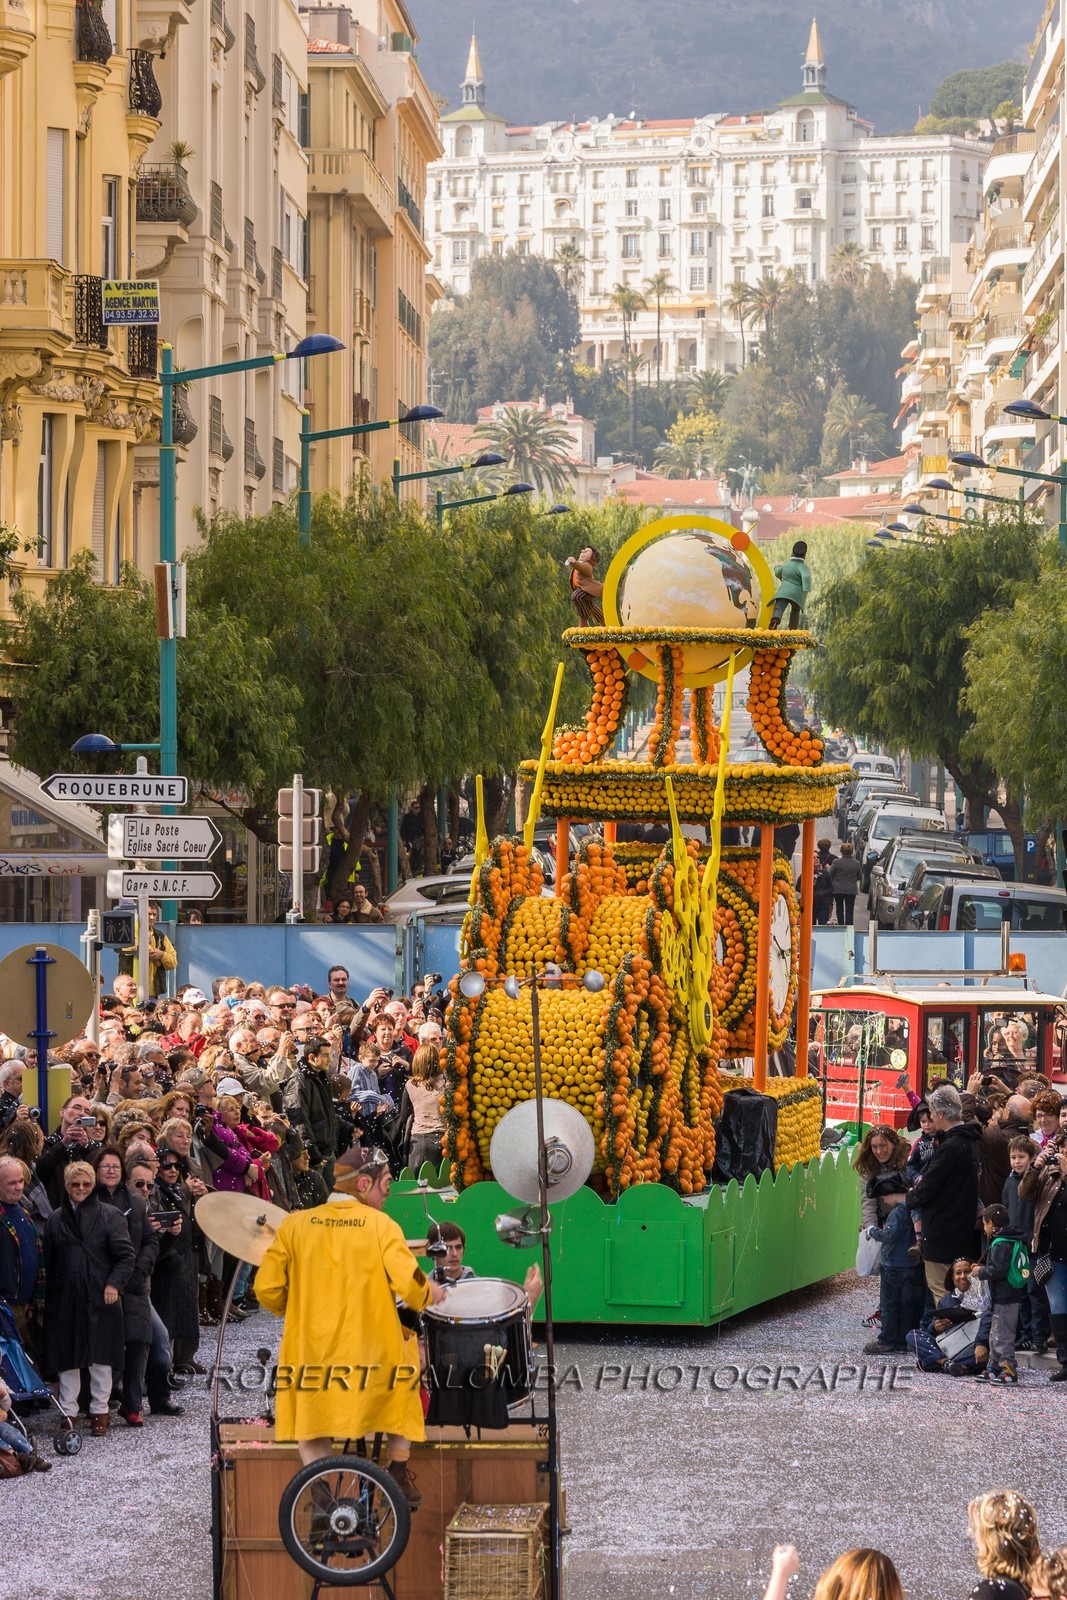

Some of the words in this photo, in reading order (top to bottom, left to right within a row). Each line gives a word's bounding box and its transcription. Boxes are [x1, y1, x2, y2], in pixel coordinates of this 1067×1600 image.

[115, 282, 157, 290] VENDRE
[105, 297, 130, 308] AGENCE
[132, 297, 158, 308] MARTINI
[106, 310, 158, 318] 04.93.57.32.32
[58, 782, 177, 797] ROQUEBRUNE
[140, 823, 150, 836] La
[154, 823, 180, 836] Poste
[127, 839, 152, 855] Eglise
[156, 839, 180, 852] Sacré
[183, 840, 207, 853] Coeur
[1027, 840, 1035, 852] P
[126, 878, 148, 892] Gare
[152, 879, 189, 892] S.N.C.F.
